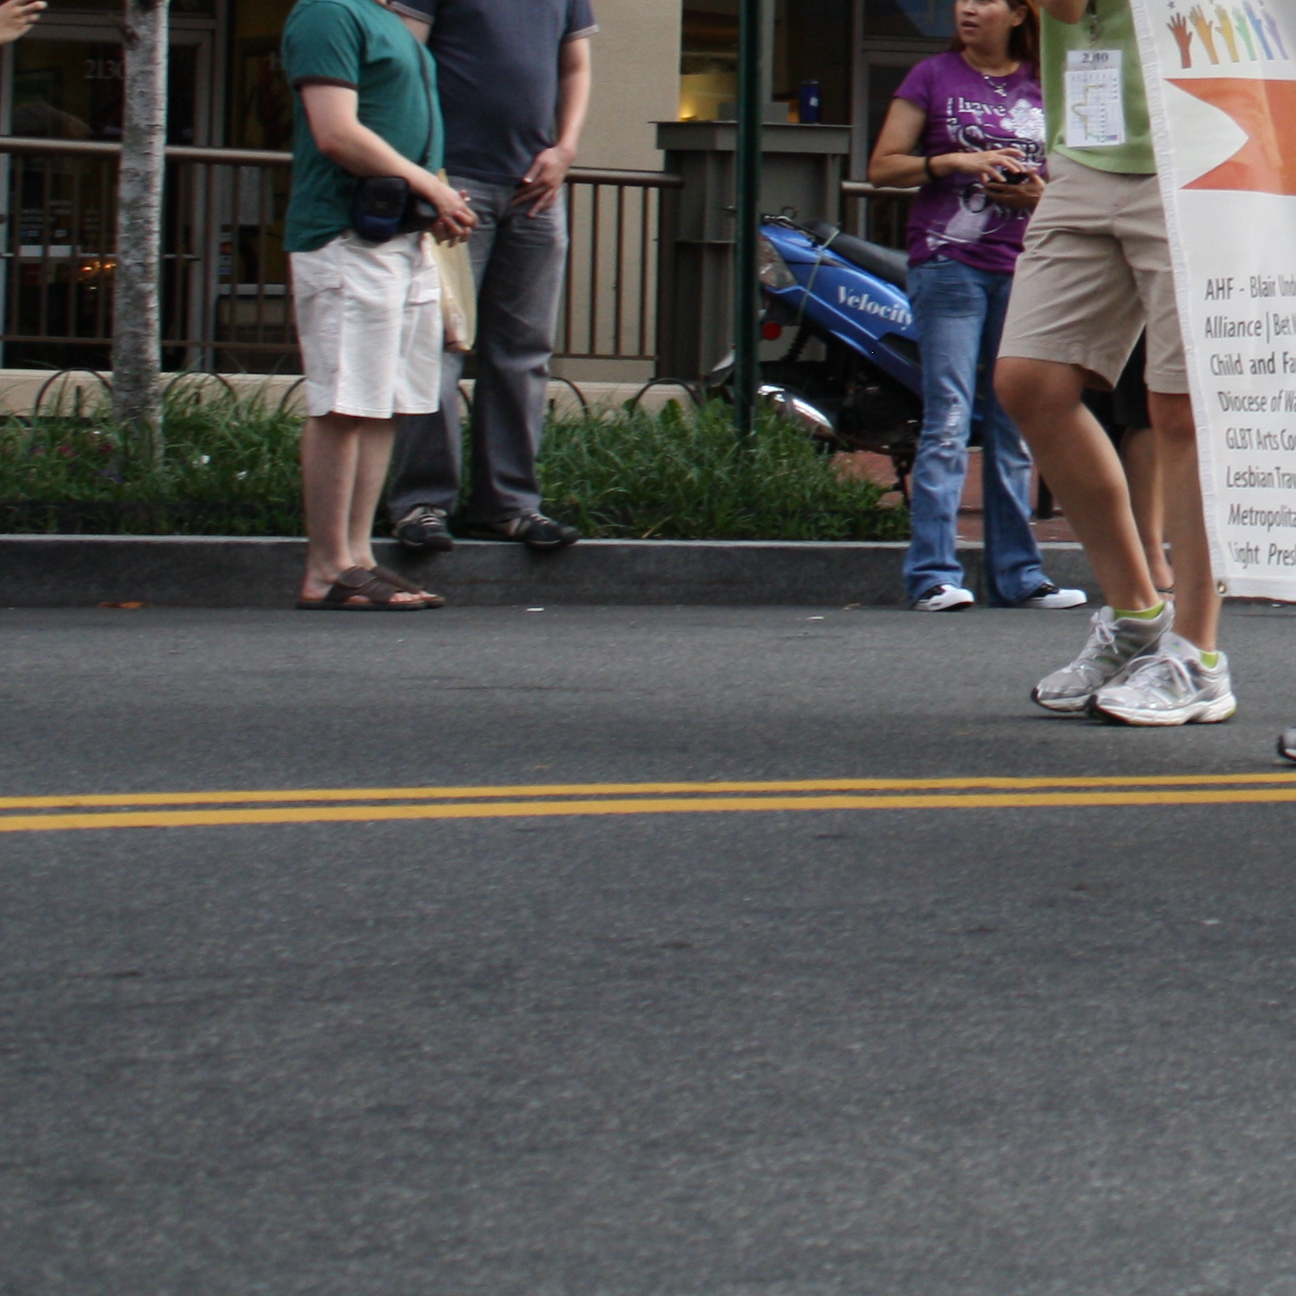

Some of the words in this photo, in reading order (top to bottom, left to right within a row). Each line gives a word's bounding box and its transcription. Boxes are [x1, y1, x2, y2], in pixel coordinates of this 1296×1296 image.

[1204, 277, 1234, 301] AHF
[837, 285, 913, 331] Velocity
[1204, 316, 1262, 338] Alliance
[1210, 354, 1242, 376] Child
[1249, 351, 1276, 375] and
[1217, 391, 1267, 413] Diocese
[1270, 390, 1284, 412] of
[1226, 428, 1252, 450] GLBT
[1257, 428, 1279, 451] Arts
[1226, 466, 1274, 488] Lesbian
